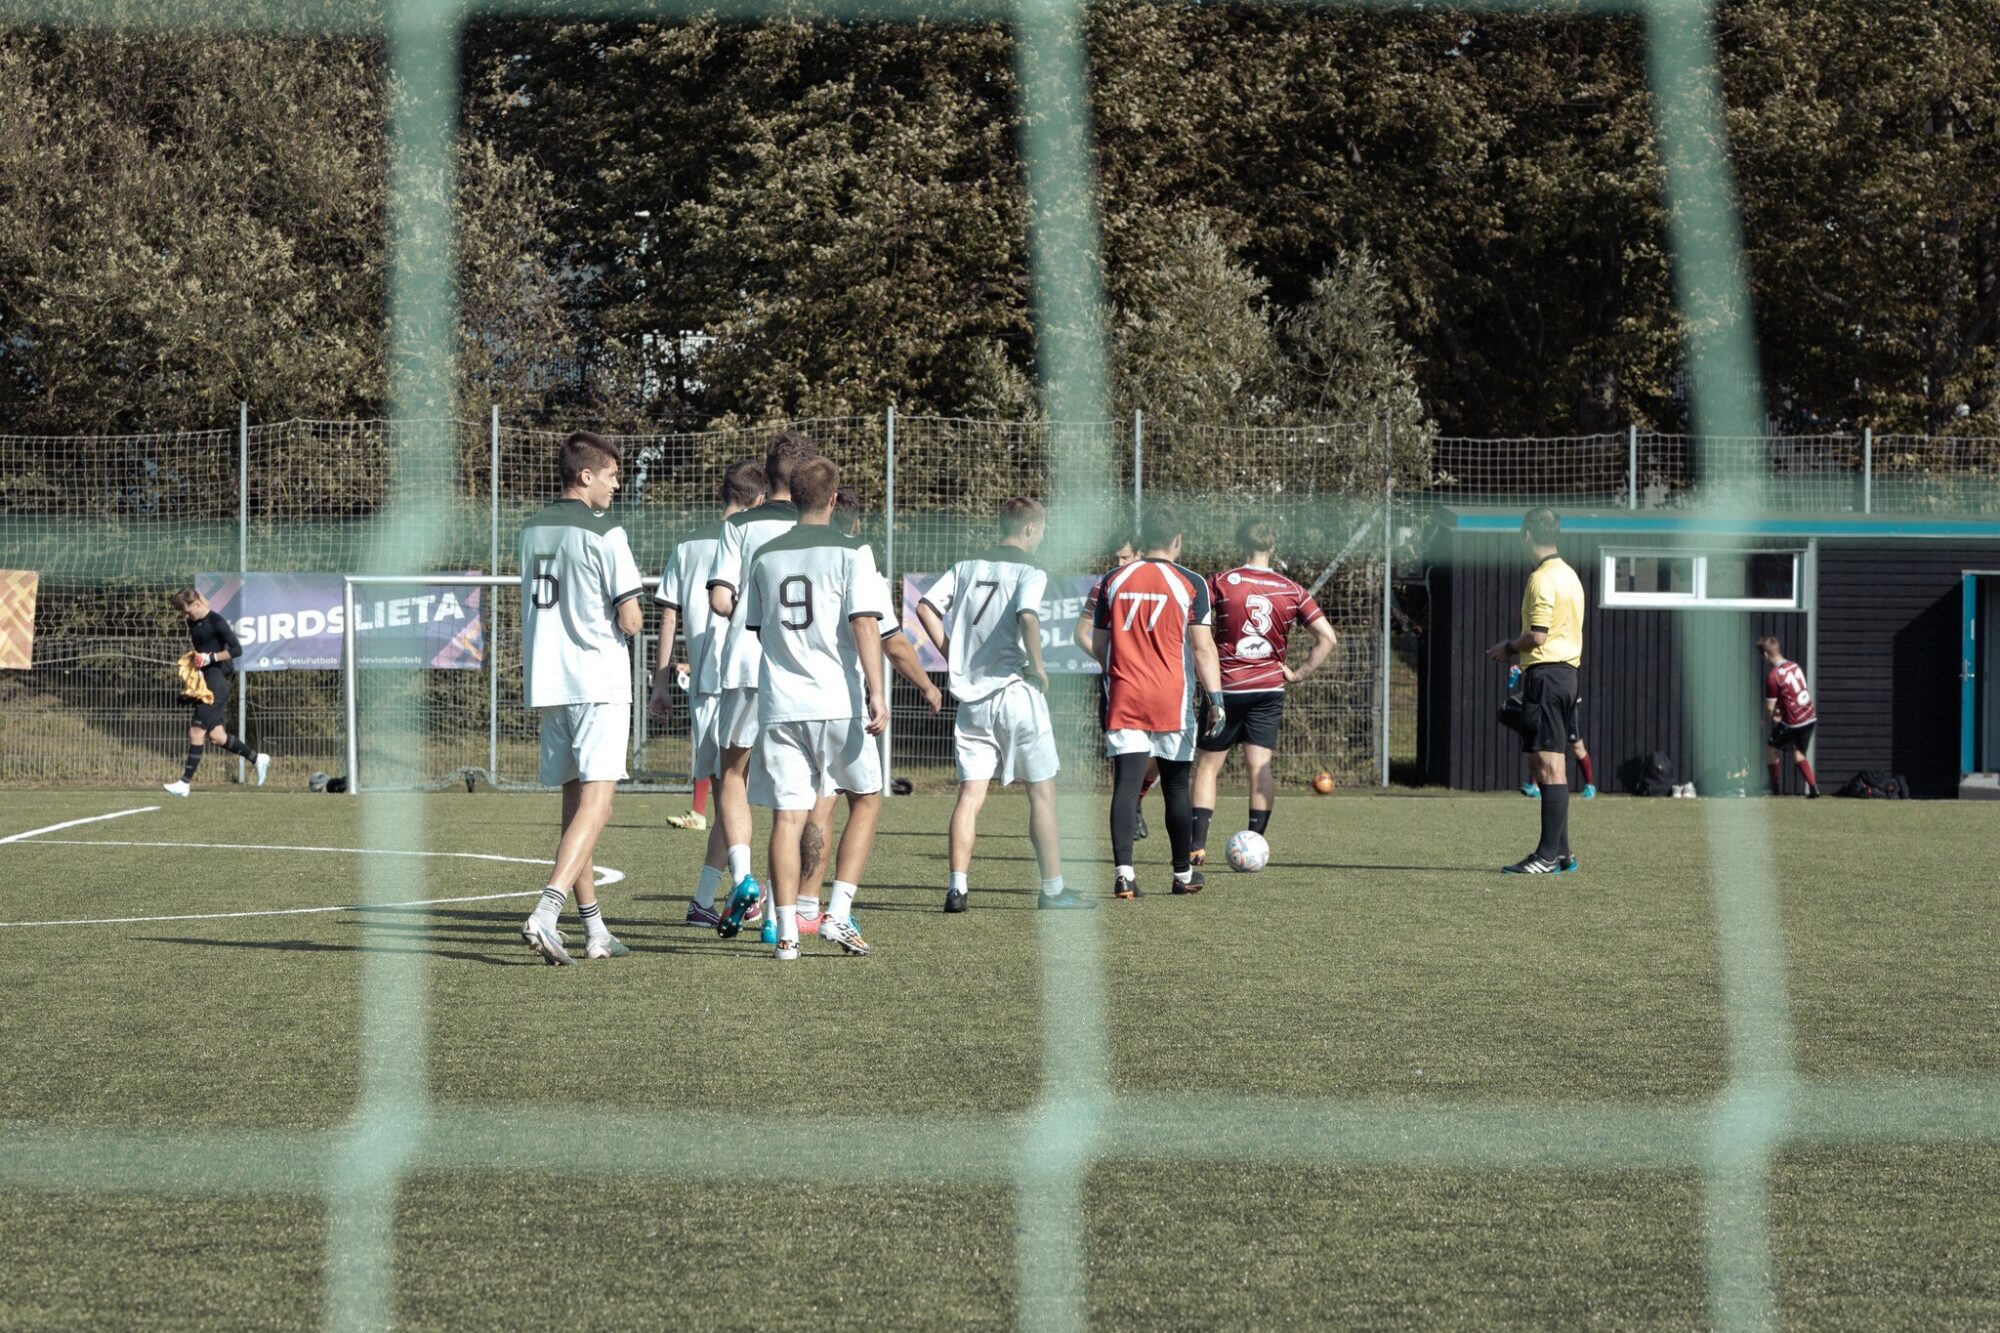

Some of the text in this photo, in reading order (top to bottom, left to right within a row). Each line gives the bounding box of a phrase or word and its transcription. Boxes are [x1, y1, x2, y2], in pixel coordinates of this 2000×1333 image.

[532, 553, 560, 610] 5
[778, 574, 815, 632] 9
[971, 580, 999, 626] 7
[1119, 592, 1168, 632] 77
[1241, 594, 1273, 636] 3
[1785, 667, 1807, 693] 11
